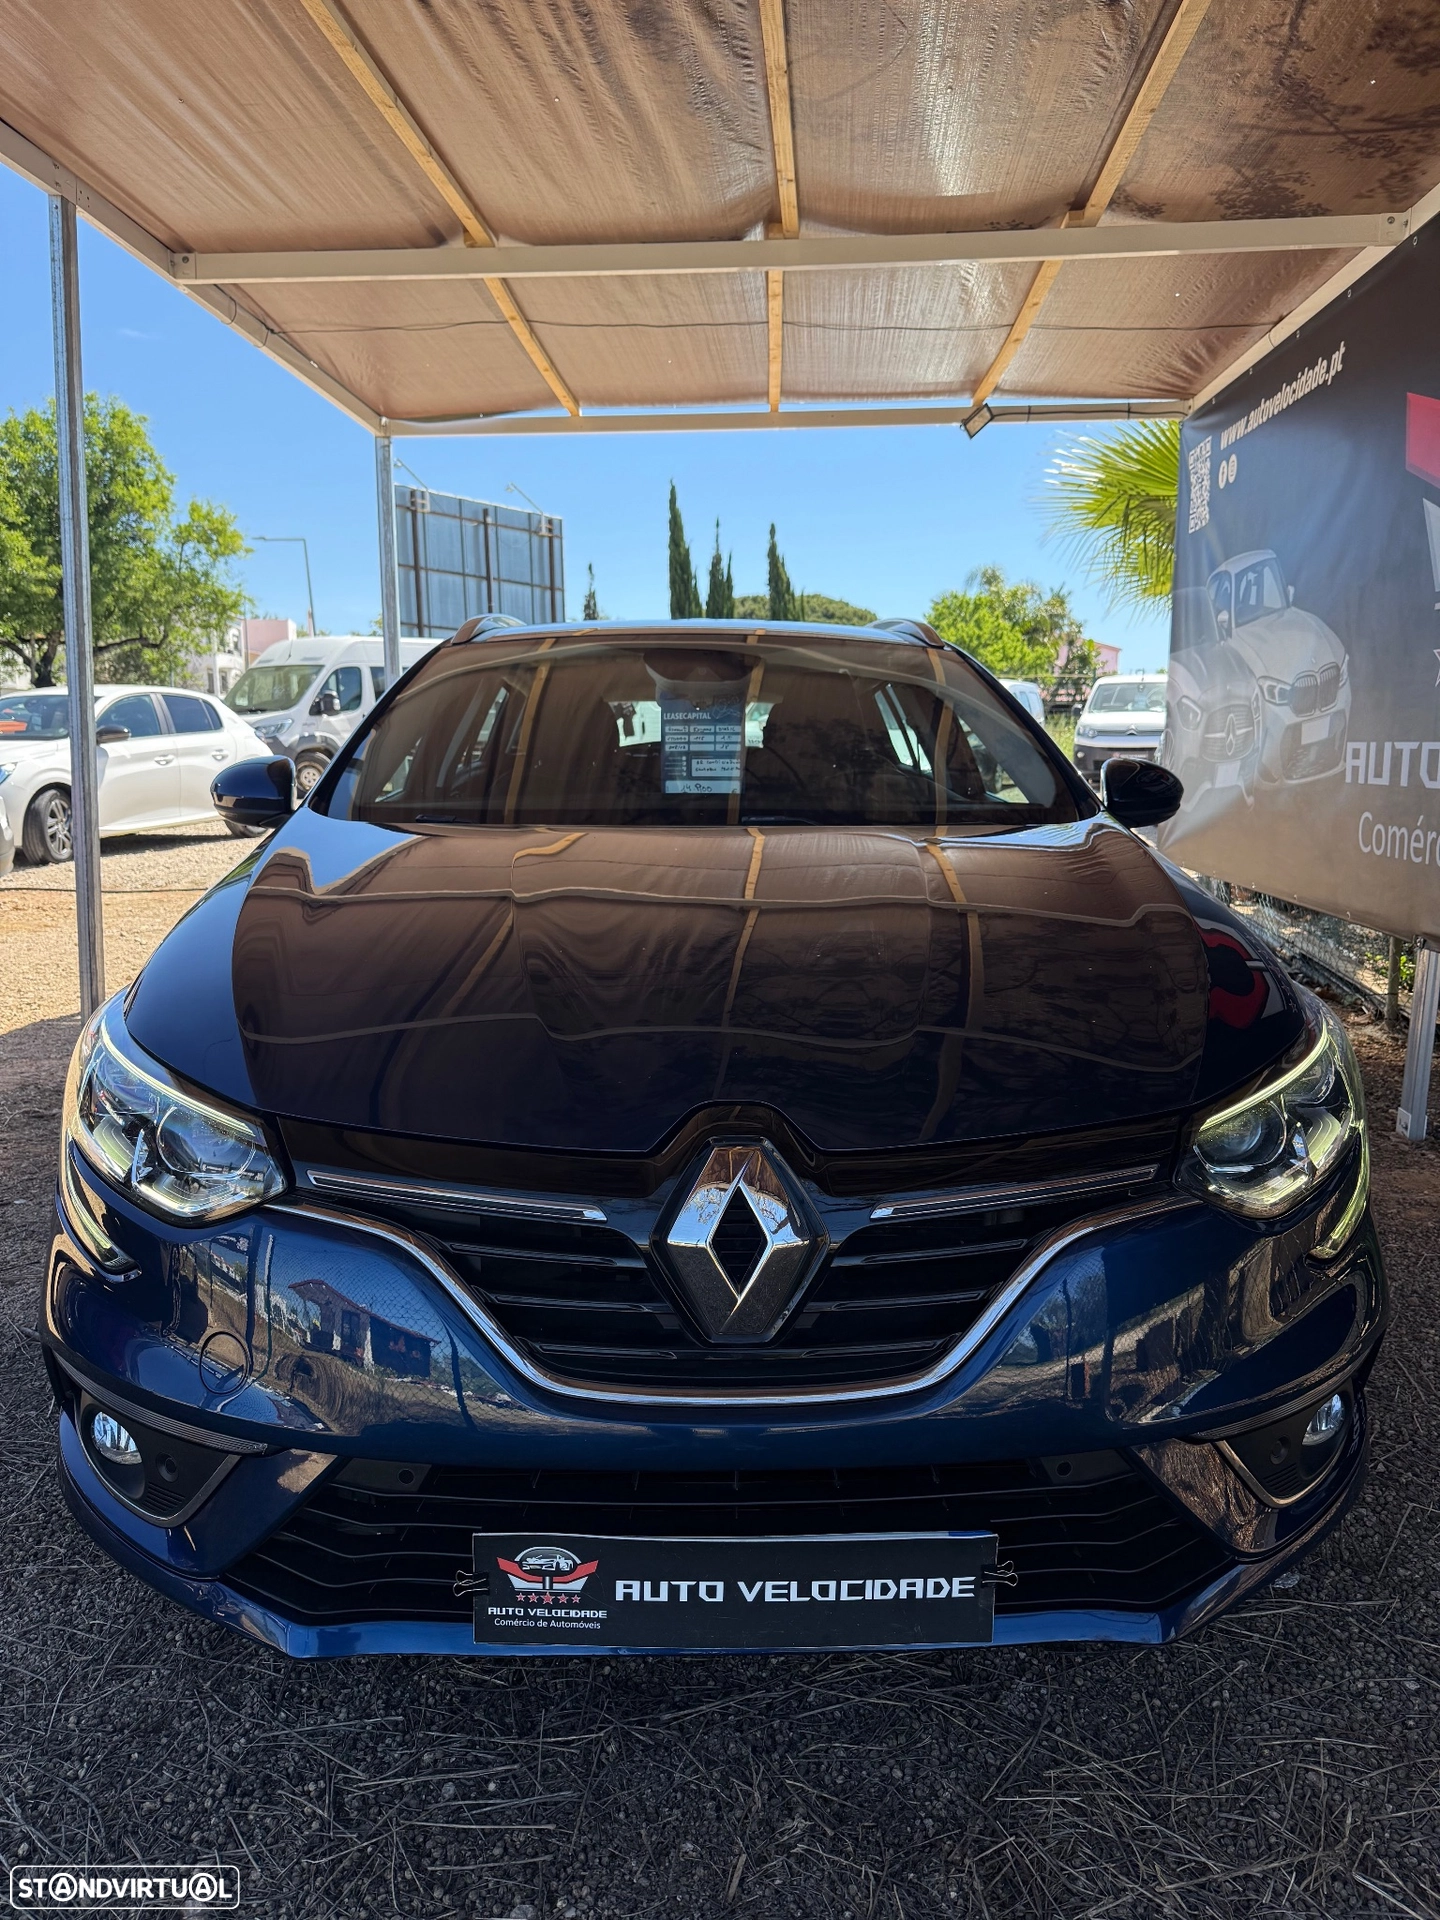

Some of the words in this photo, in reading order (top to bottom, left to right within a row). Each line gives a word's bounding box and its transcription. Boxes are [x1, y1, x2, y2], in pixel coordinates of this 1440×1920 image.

[1220, 341, 1346, 450] www.autovelocidade.pt
[663, 712, 711, 720] LEASECAPITAL
[1345, 741, 1440, 789] AUTO
[615, 1580, 725, 1602] AUTO
[737, 1576, 977, 1602] VELOCIDADE
[487, 1607, 524, 1616] AUTO
[527, 1608, 608, 1619] VELOCIDADE
[494, 1618, 535, 1627] Comércio
[537, 1619, 548, 1628] de
[549, 1620, 601, 1630] Automóveis
